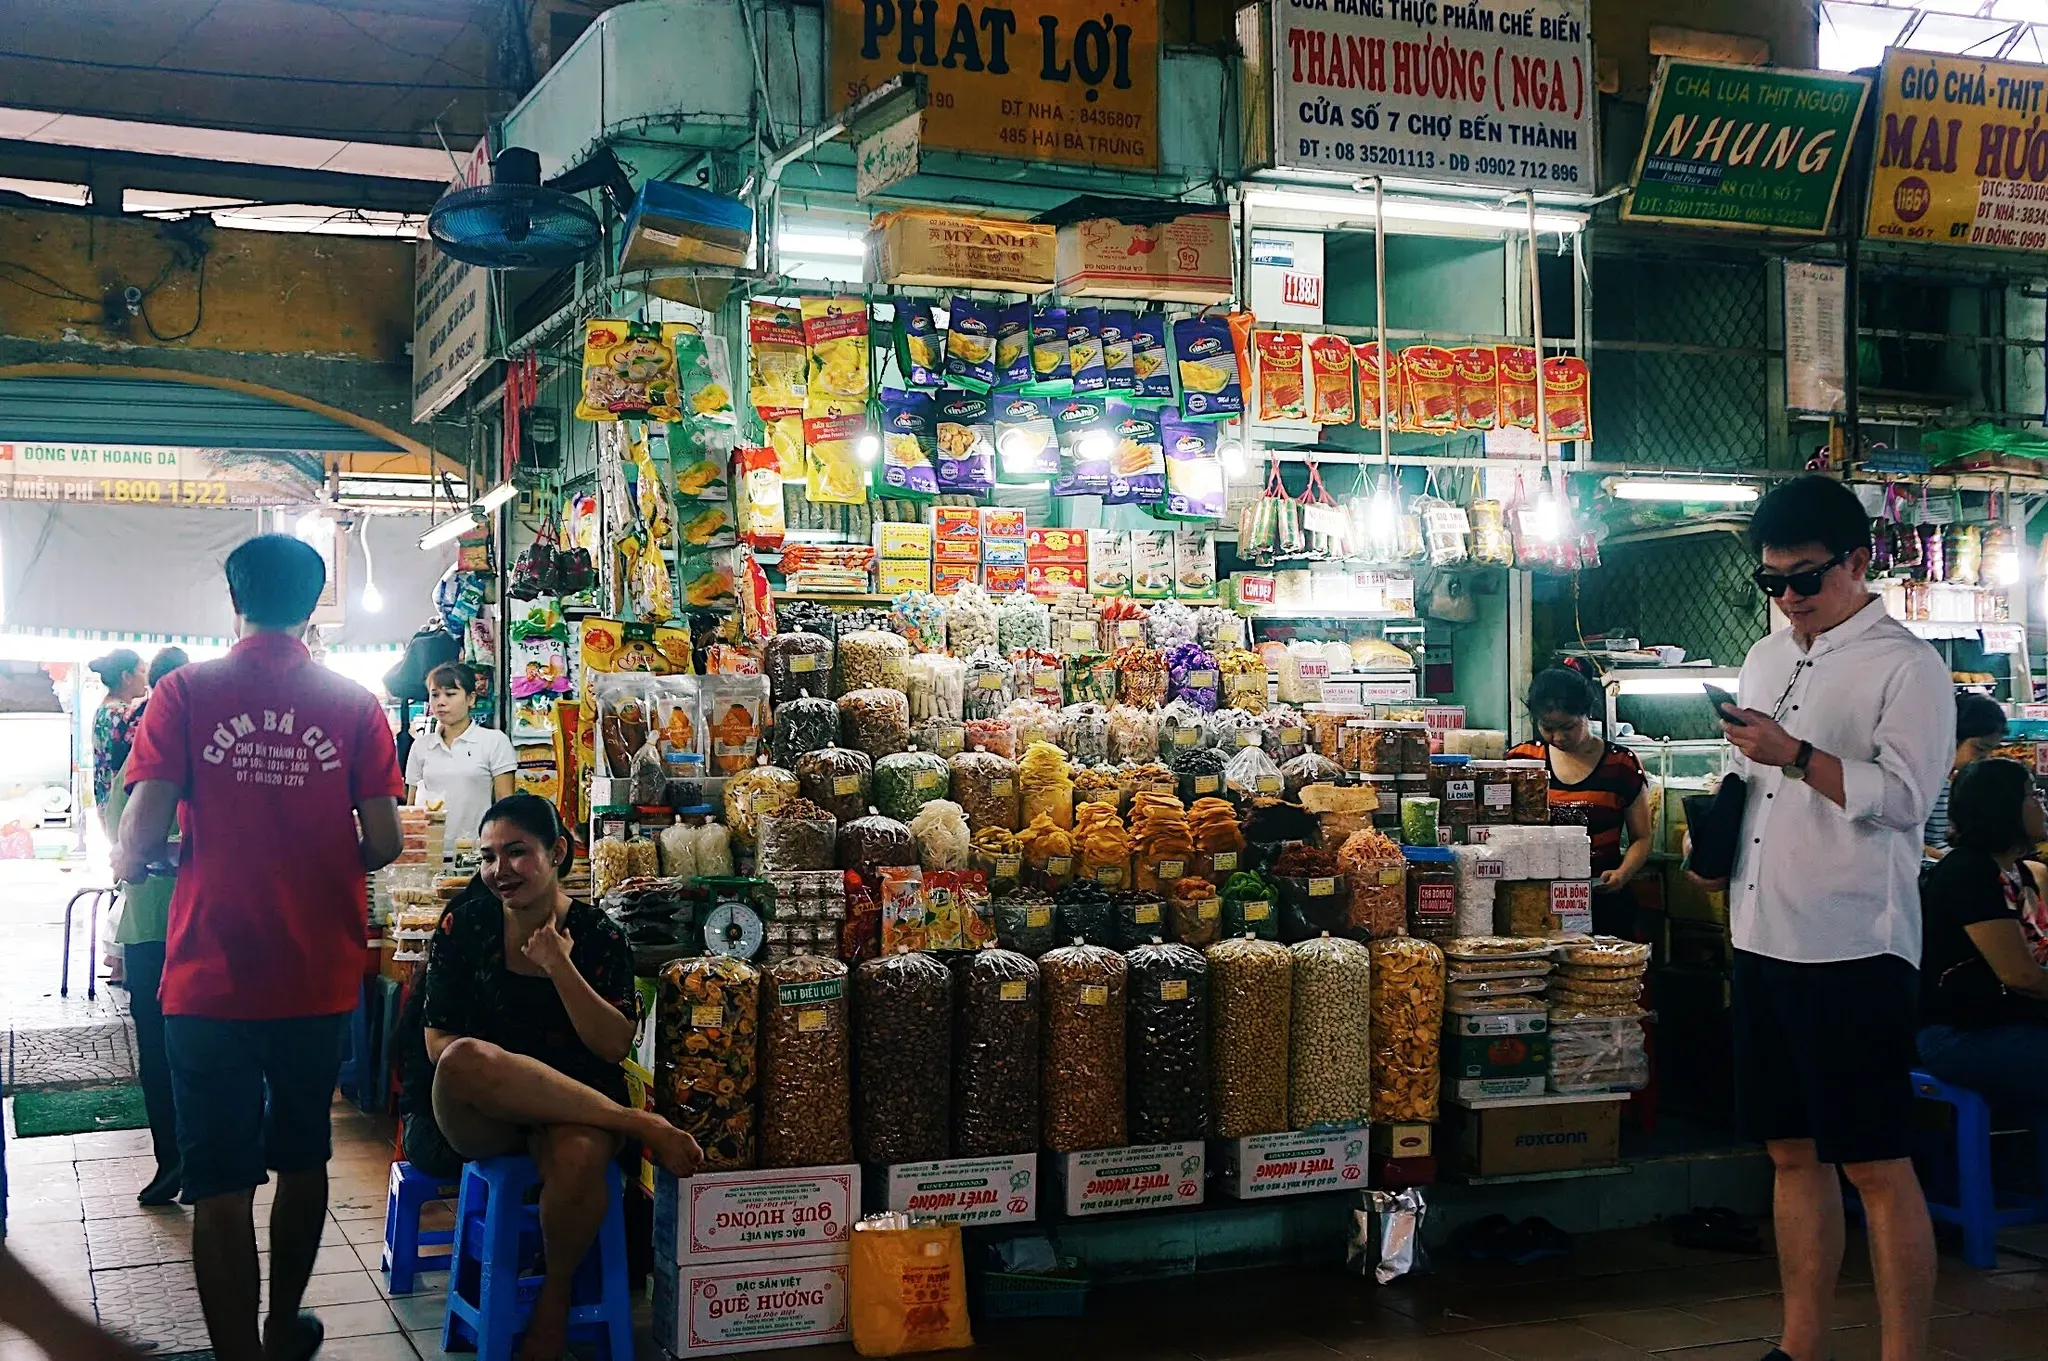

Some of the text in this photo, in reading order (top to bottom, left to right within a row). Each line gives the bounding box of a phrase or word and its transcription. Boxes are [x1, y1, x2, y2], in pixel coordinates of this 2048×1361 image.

[1500, 8, 1535, 37] CHẾ
[1540, 12, 1581, 43] BIẾN
[1038, 13, 1132, 102] LỢI
[1288, 28, 1386, 92] THANH
[1392, 31, 1486, 103] HƯƠNG
[1902, 59, 1939, 101] GIÒ
[1080, 108, 1142, 129] 8436807
[1299, 96, 1577, 150] CỬA SỐ 7 CHỢ BẾN THÀNH
[1000, 127, 1027, 143] 485
[1033, 130, 1059, 148] HAI
[1655, 113, 1836, 175] NHUNG
[1880, 113, 1962, 174] MAI
[1335, 142, 1355, 161] 08
[1360, 145, 1435, 169] 35201113
[1521, 161, 1548, 179] 712
[1551, 163, 1578, 182] 896
[2008, 182, 2048, 201] 352010
[2020, 206, 2048, 225] 3834
[981, 233, 1025, 247] ANH
[2020, 231, 2047, 248] 0909
[1286, 274, 1319, 304] 1188A
[103, 450, 152, 464] HOANG
[100, 480, 161, 503] 1800
[168, 481, 227, 505] 1522
[1453, 781, 1469, 791] GÀ
[1554, 884, 1588, 899] CHÀ BÔNG
[782, 989, 797, 1001] HẠT
[1299, 1158, 1334, 1178] TUYẾT
[1132, 1173, 1170, 1195] TUYẾT
[957, 1190, 999, 1210] TUYẾT
[716, 1201, 832, 1228] QUÊ HƯƠNG
[736, 1276, 801, 1293] ĐẶC SẢN VIỆT
[709, 1290, 824, 1319] QUÊ HƯƠNG
